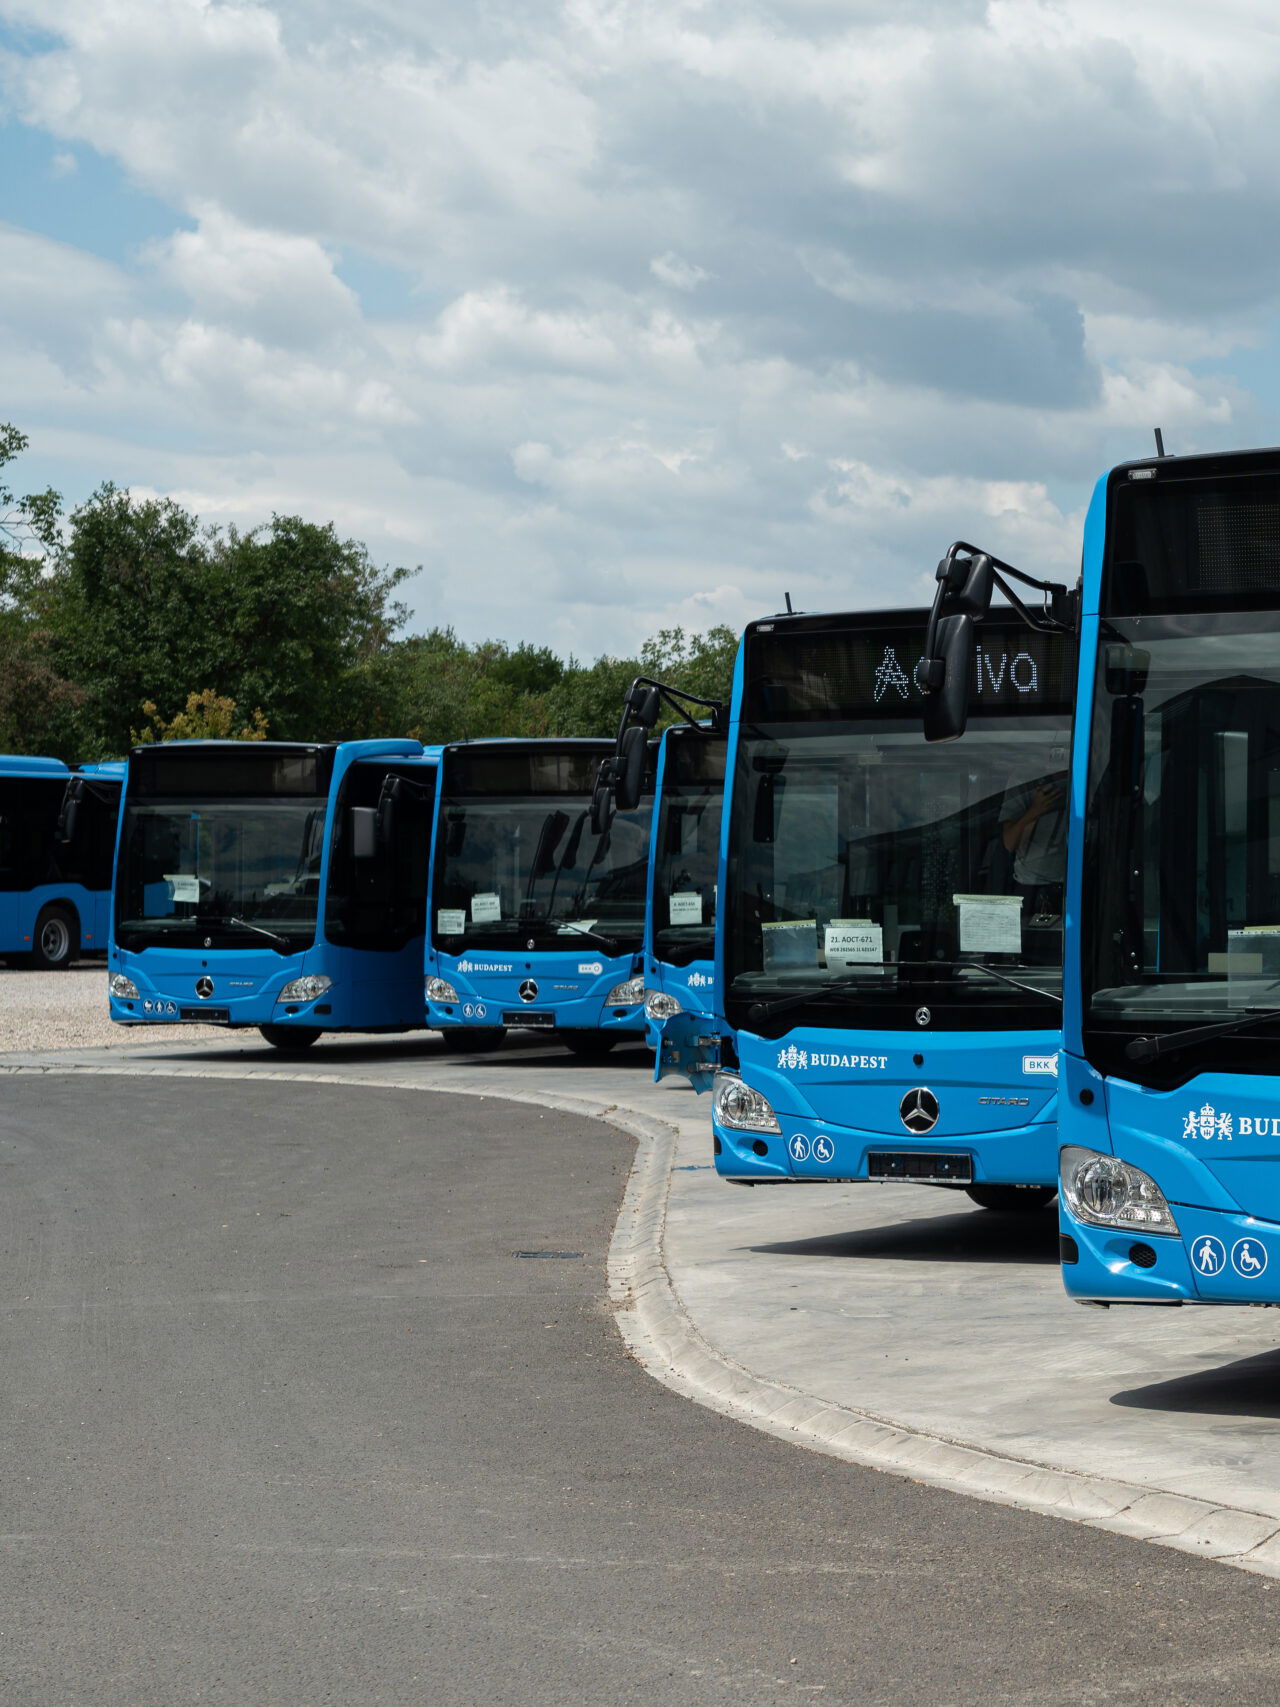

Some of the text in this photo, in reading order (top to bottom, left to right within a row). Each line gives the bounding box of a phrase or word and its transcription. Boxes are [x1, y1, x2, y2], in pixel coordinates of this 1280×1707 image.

[474, 963, 512, 972] BUDAPEST
[811, 1053, 887, 1069] BUDAPEST
[1029, 1061, 1050, 1069] BKK
[978, 1096, 1030, 1105] CITARO
